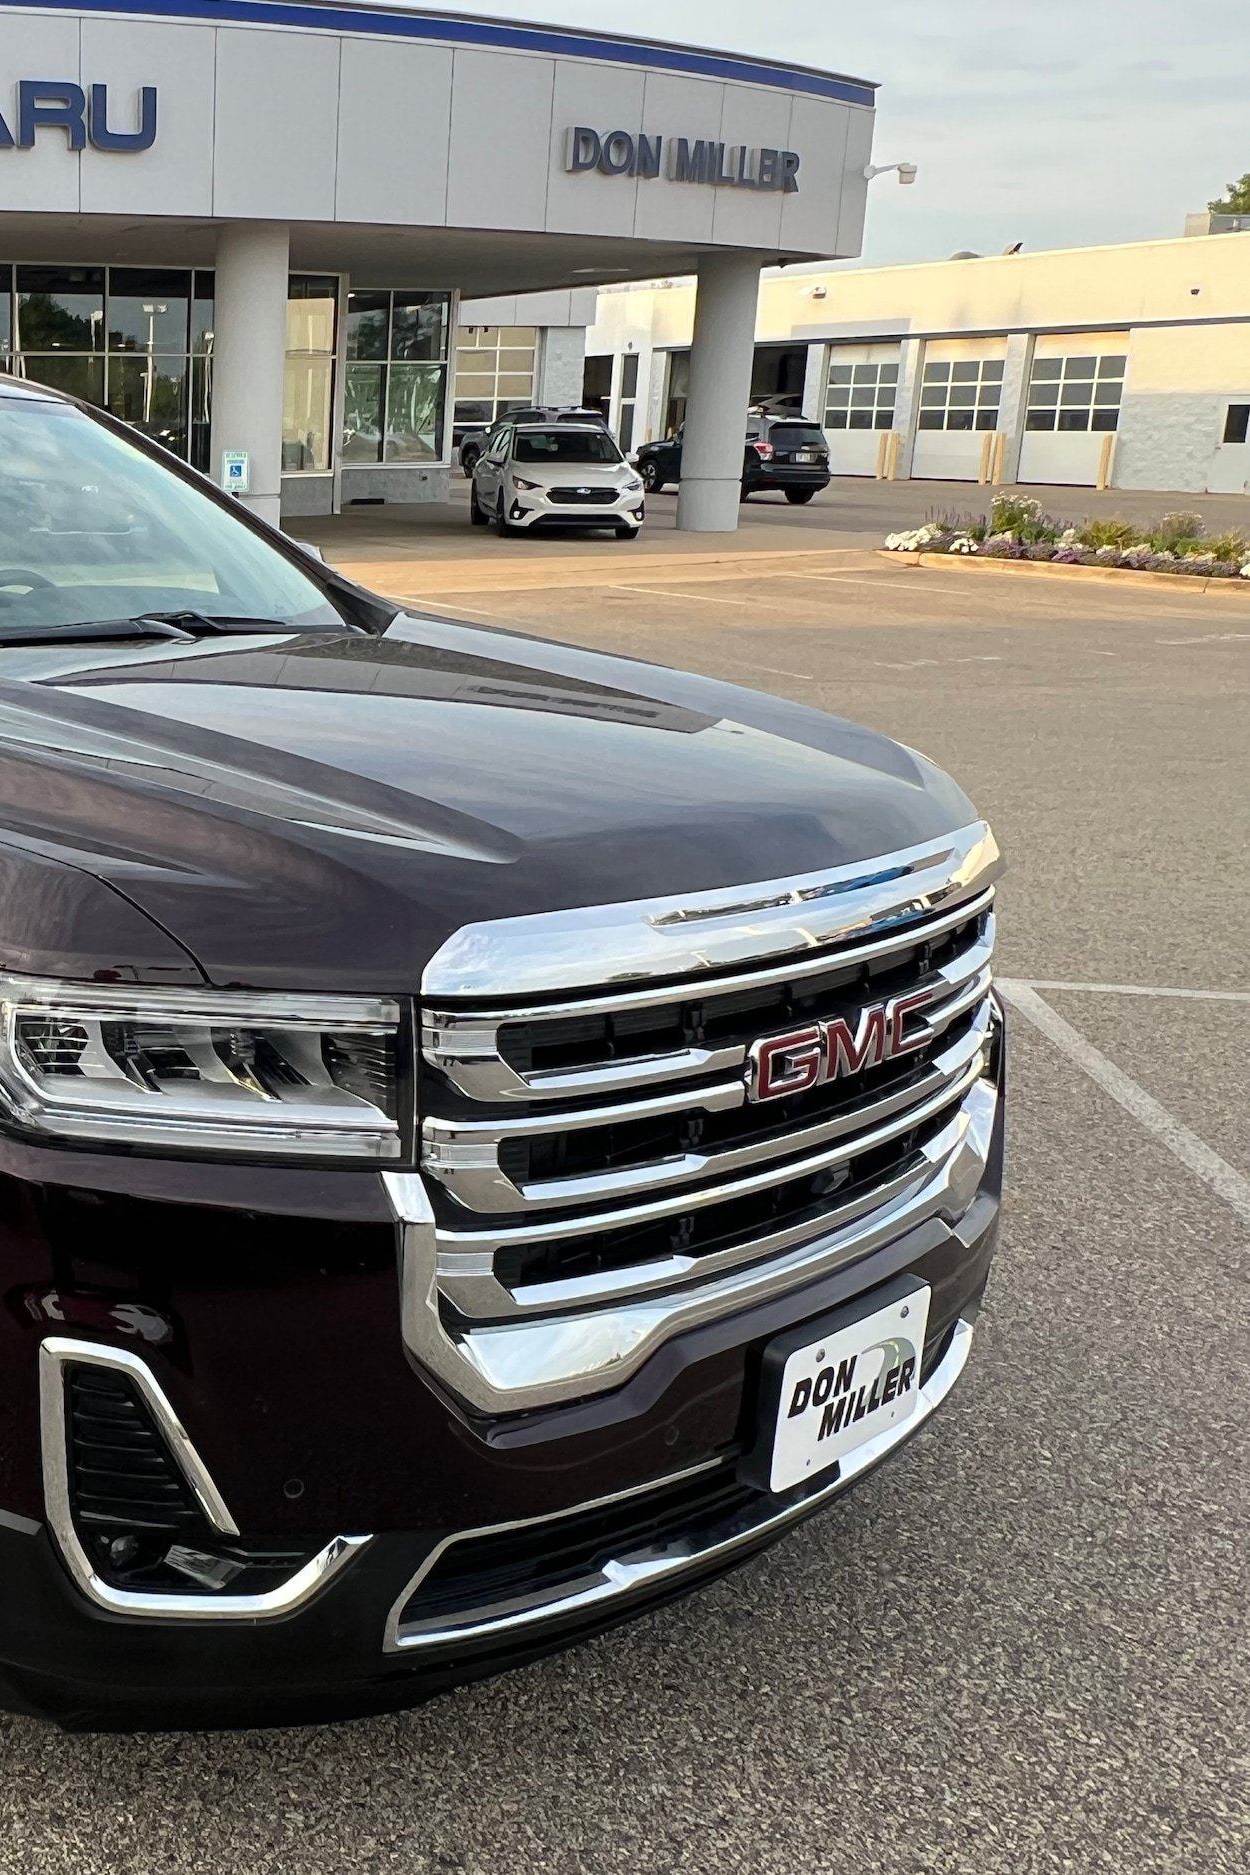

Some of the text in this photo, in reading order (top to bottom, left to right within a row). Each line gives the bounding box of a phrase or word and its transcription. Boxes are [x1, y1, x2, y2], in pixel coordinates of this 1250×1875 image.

[566, 127, 800, 193] DON MILLER
[747, 985, 936, 1104] GMC
[787, 1354, 858, 1419] DON
[817, 1356, 915, 1441] MILLER
